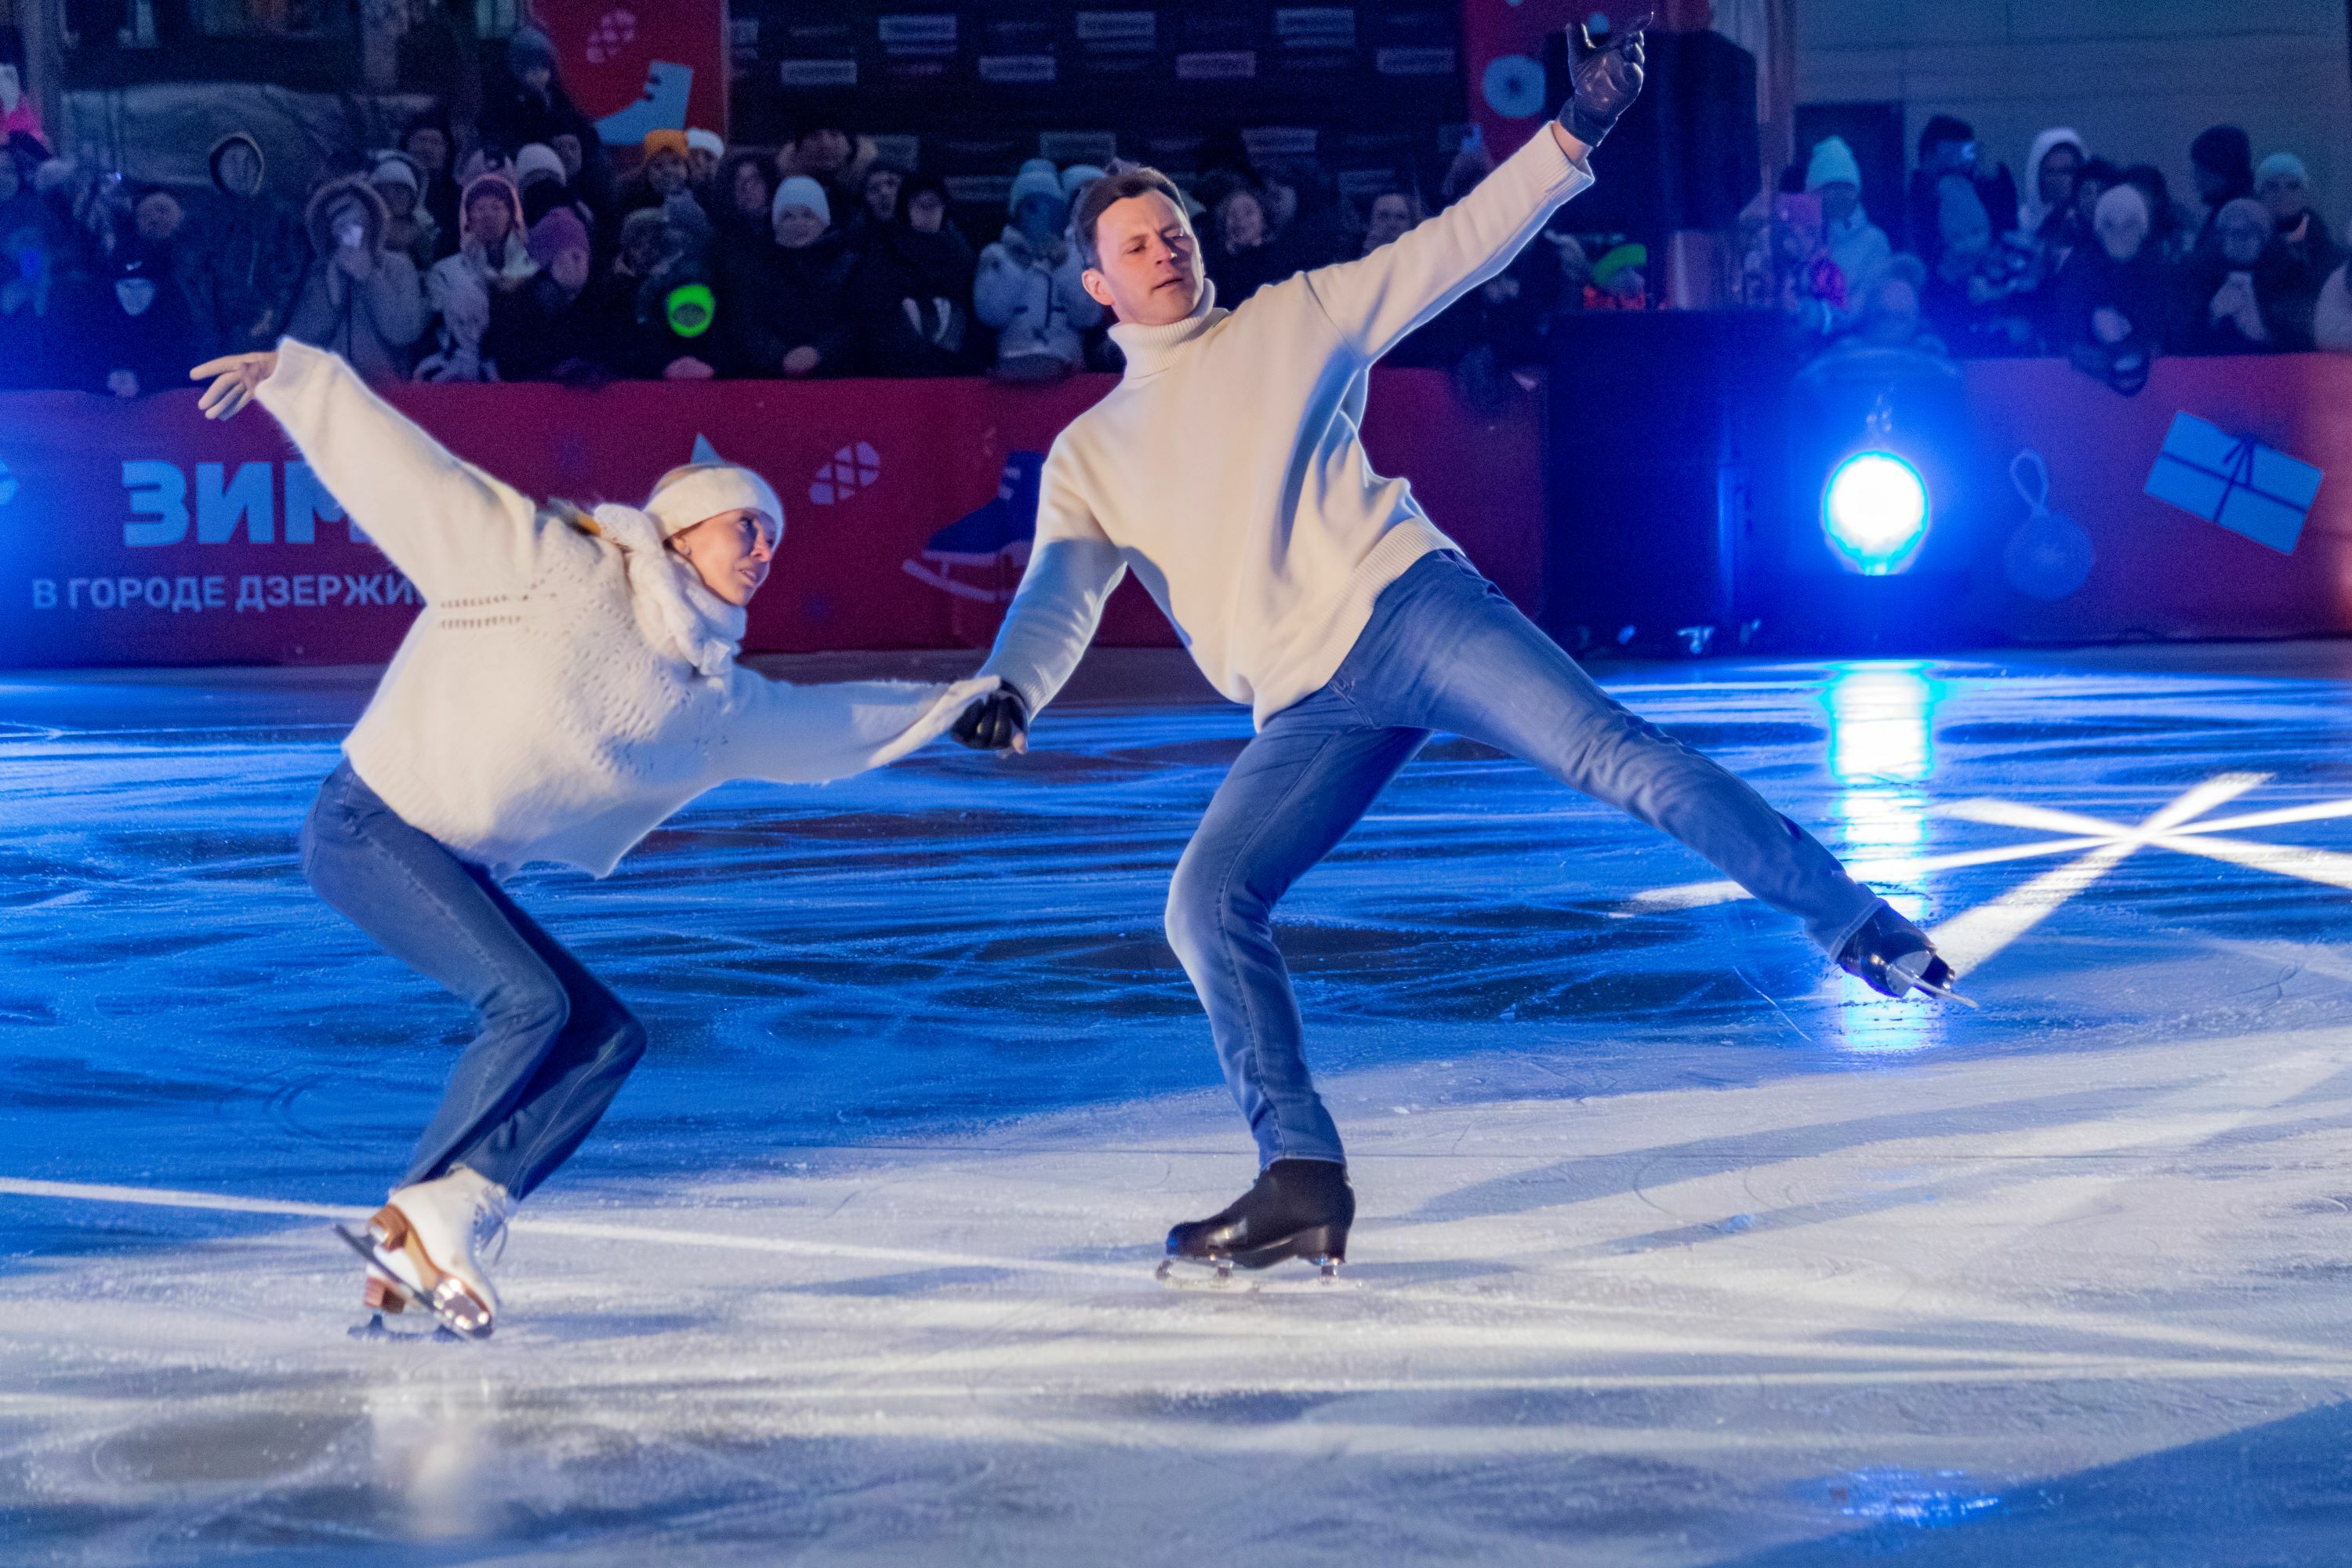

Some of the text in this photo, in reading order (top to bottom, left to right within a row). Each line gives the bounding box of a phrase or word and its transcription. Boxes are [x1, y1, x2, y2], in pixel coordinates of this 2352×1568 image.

[32, 574, 425, 612] В ГОРОДЕ ДЗЕРЖИ
